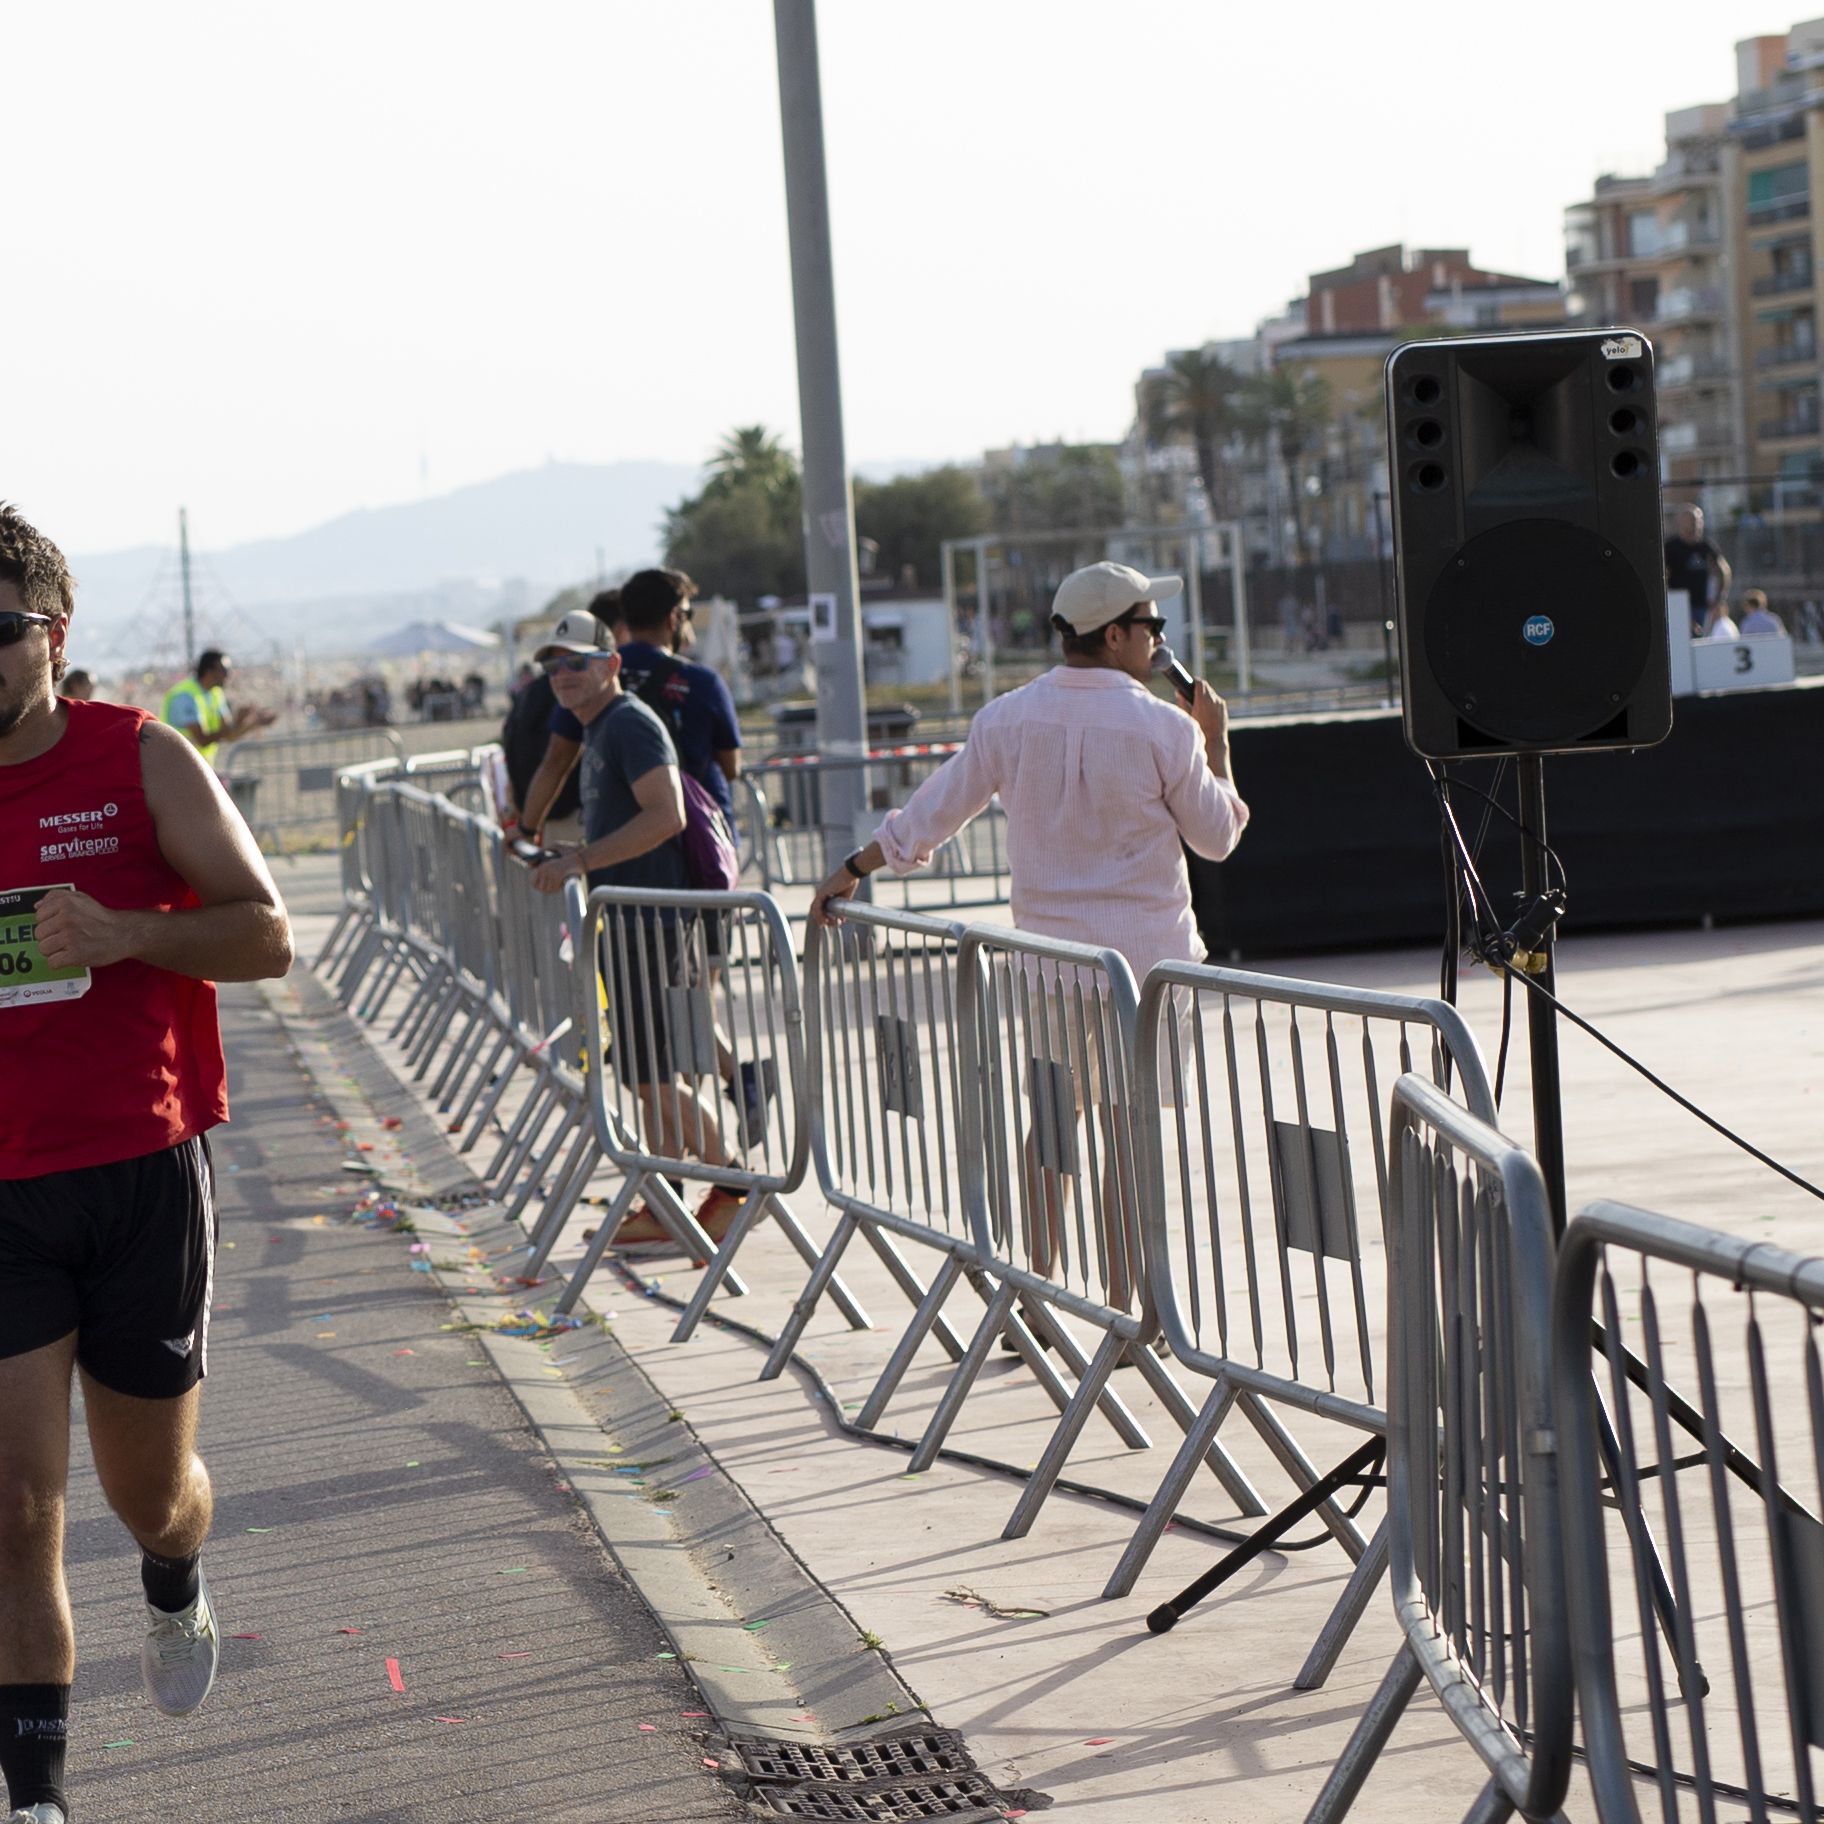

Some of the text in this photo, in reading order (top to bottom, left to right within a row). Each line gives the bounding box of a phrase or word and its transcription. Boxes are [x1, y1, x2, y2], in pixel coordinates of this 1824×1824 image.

[1527, 622, 1550, 636] RCF
[1734, 645, 1753, 673] 3
[39, 811, 103, 828] MESSER
[40, 837, 119, 856] servirepro
